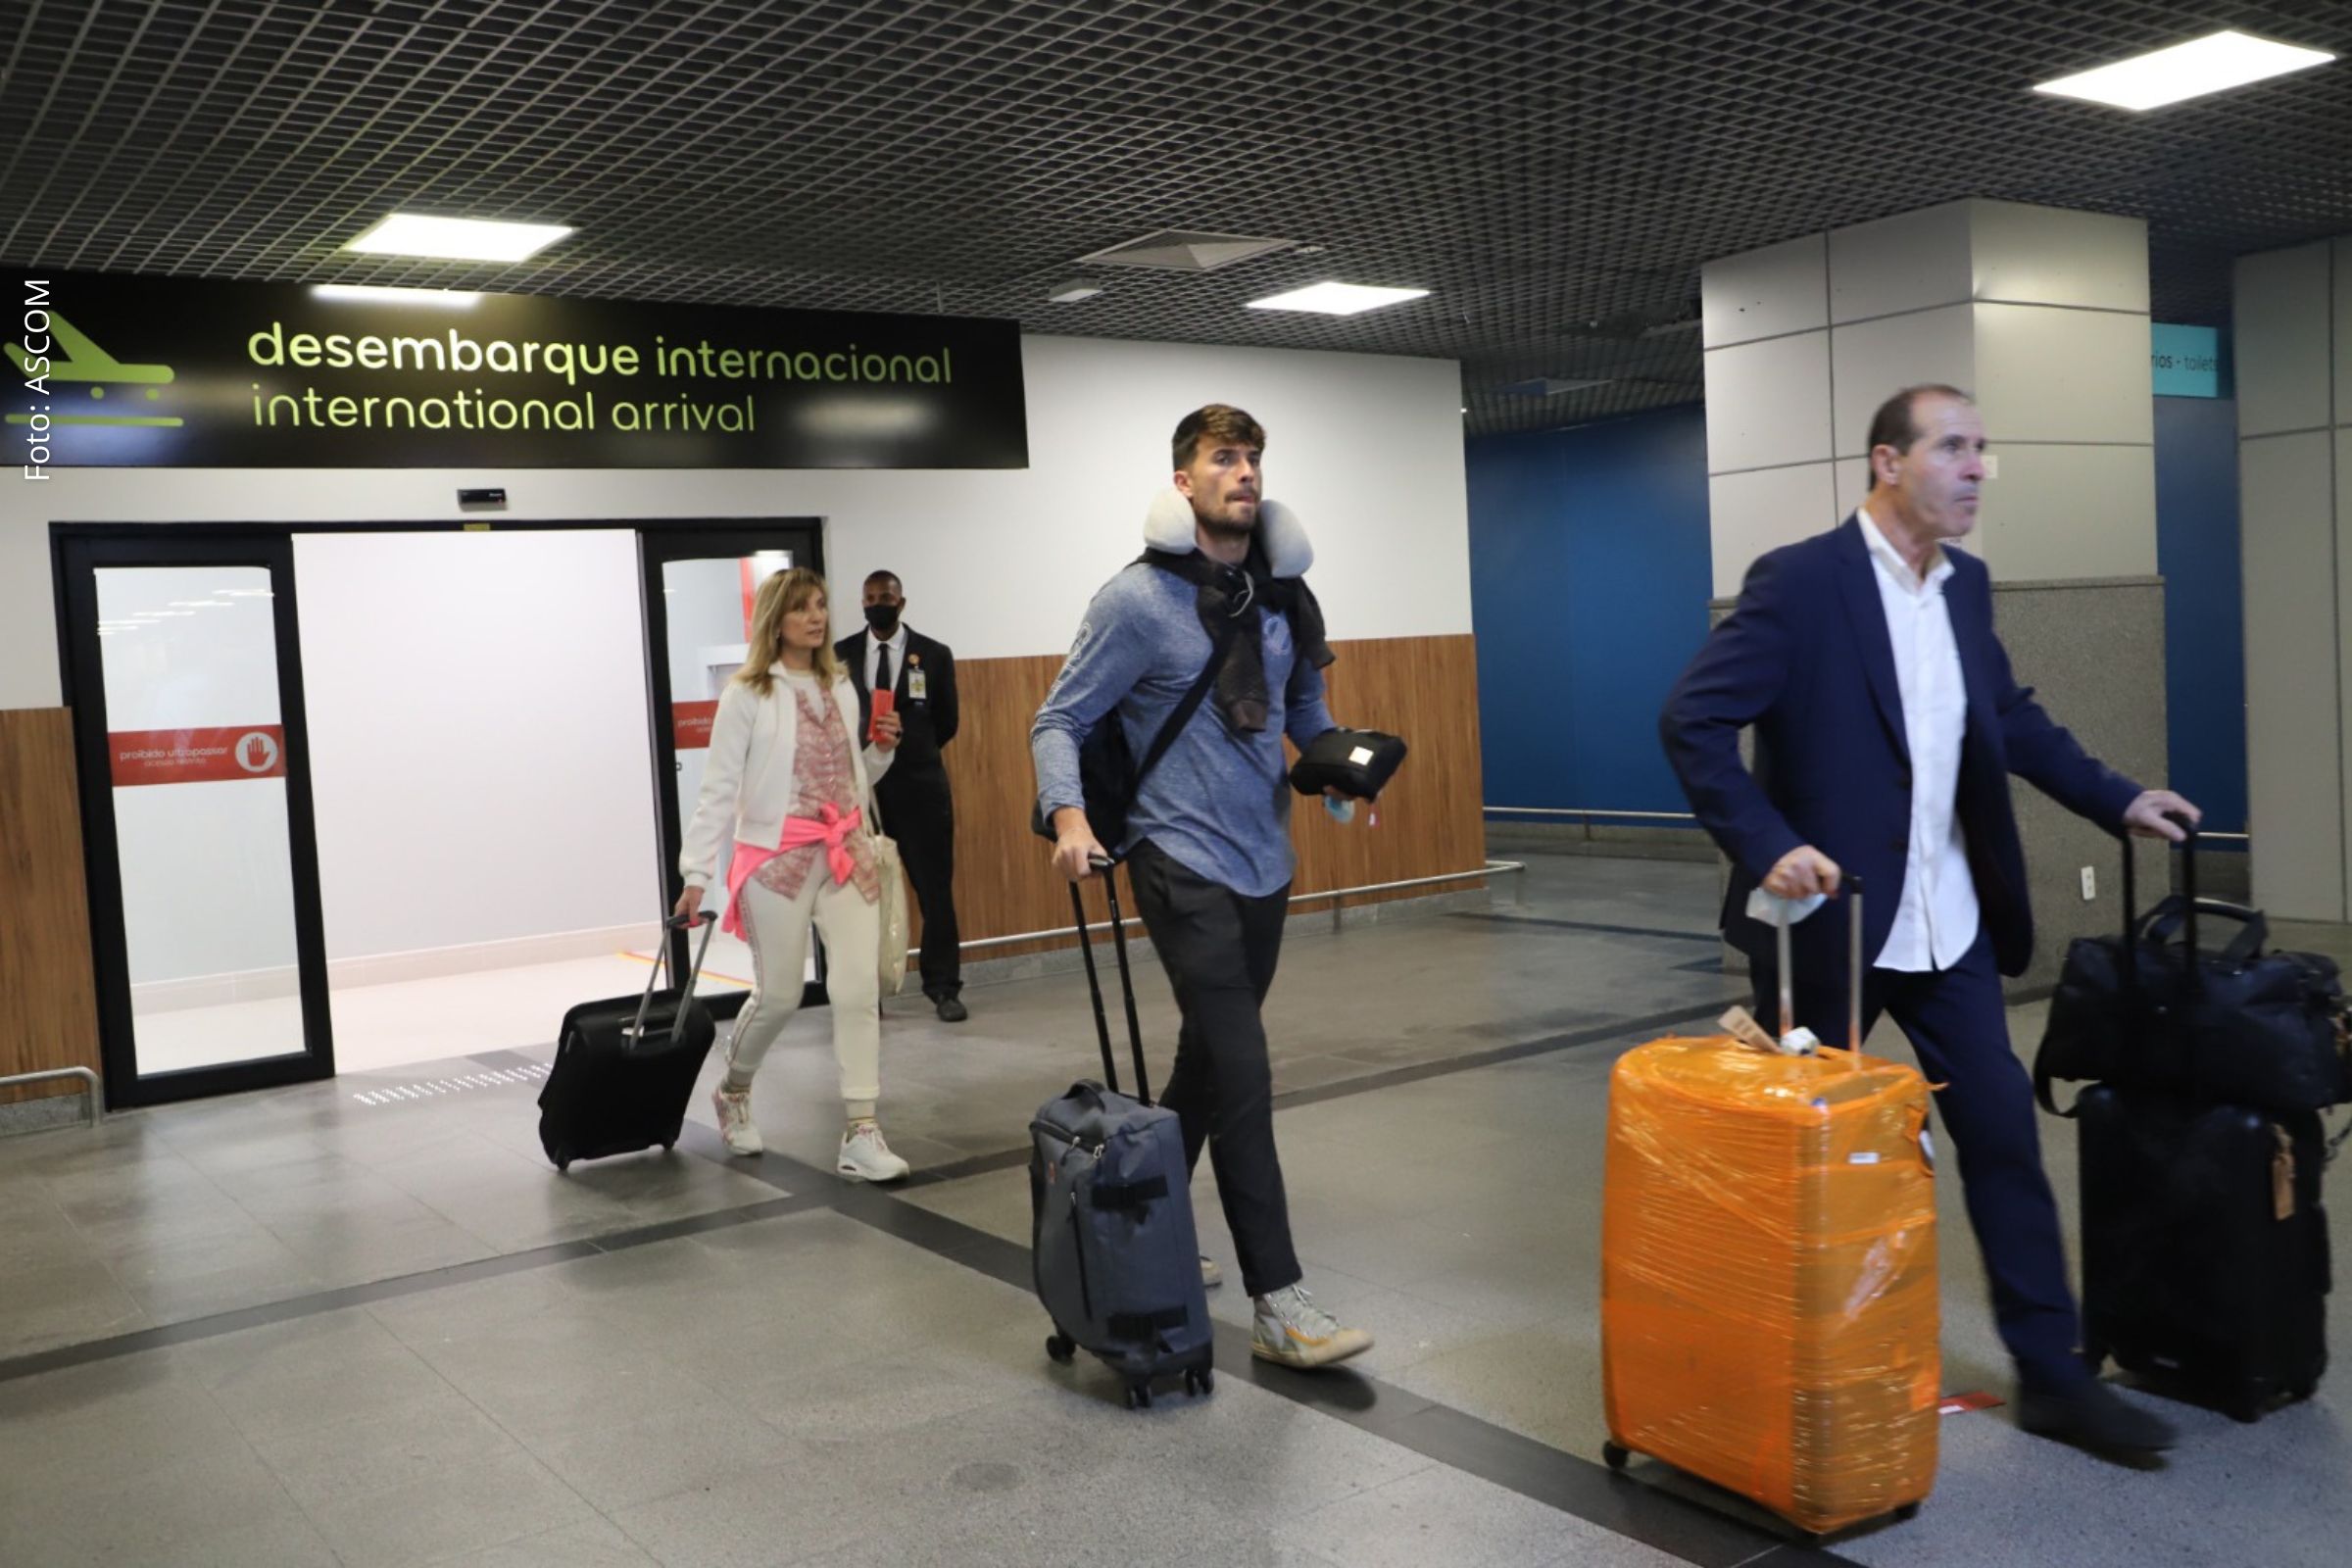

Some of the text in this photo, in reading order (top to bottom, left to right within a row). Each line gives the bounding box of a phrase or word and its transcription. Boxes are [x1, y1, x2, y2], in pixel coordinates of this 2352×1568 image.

[248, 321, 952, 386] desembarque internacional
[251, 383, 755, 431] international arrival
[120, 749, 165, 761] proibido
